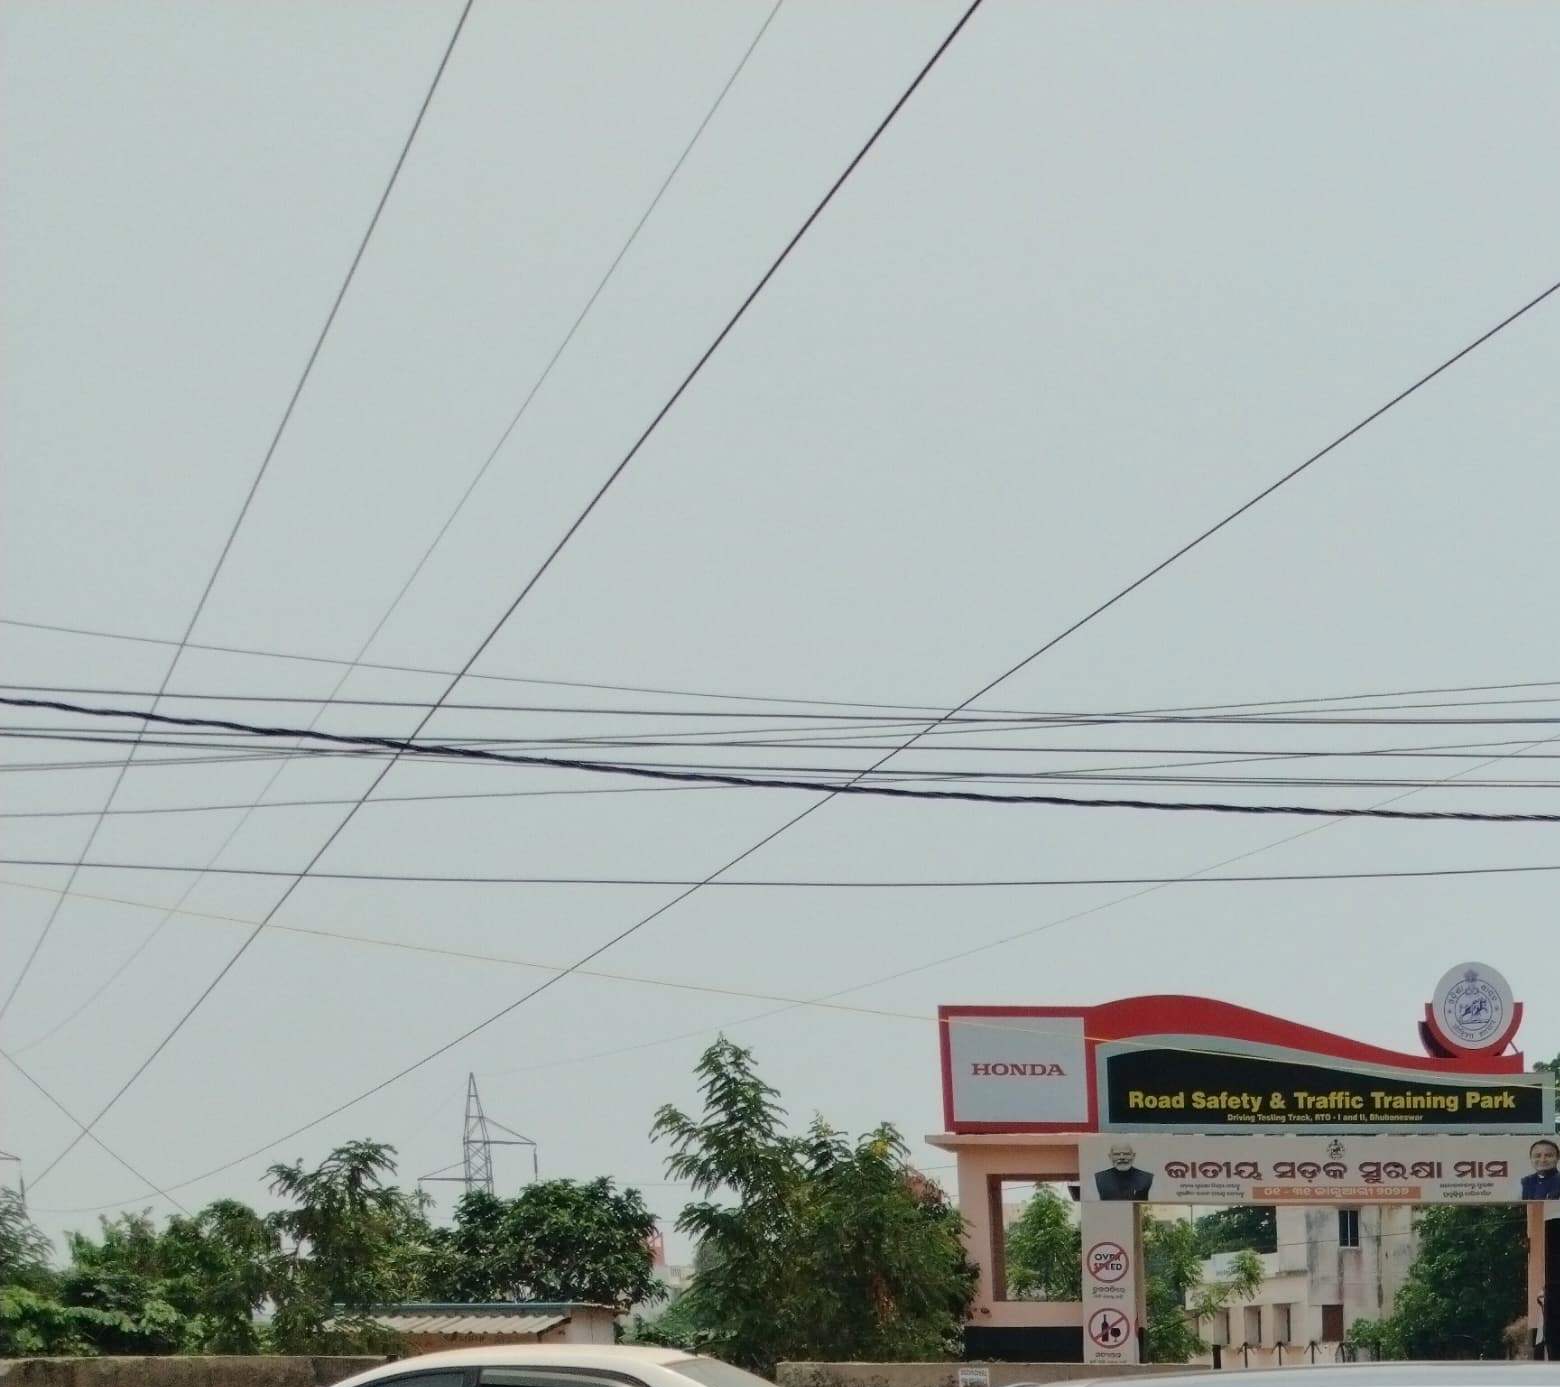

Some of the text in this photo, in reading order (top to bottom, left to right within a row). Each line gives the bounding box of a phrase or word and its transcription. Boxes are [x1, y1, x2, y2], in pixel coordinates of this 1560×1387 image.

[971, 1063, 1067, 1076] HONDA
[1128, 1091, 1516, 1112] Road Safety & Traffic Training Park
[1227, 1113, 1256, 1122] Driving
[1288, 1113, 1313, 1122] Track,
[1315, 1113, 1331, 1121] RTO
[1343, 1113, 1358, 1121] and
[1164, 1160, 1509, 1184] ଜାତୀୟ ସଡ଼କ ସୁରକ୍ଷା ମାସ
